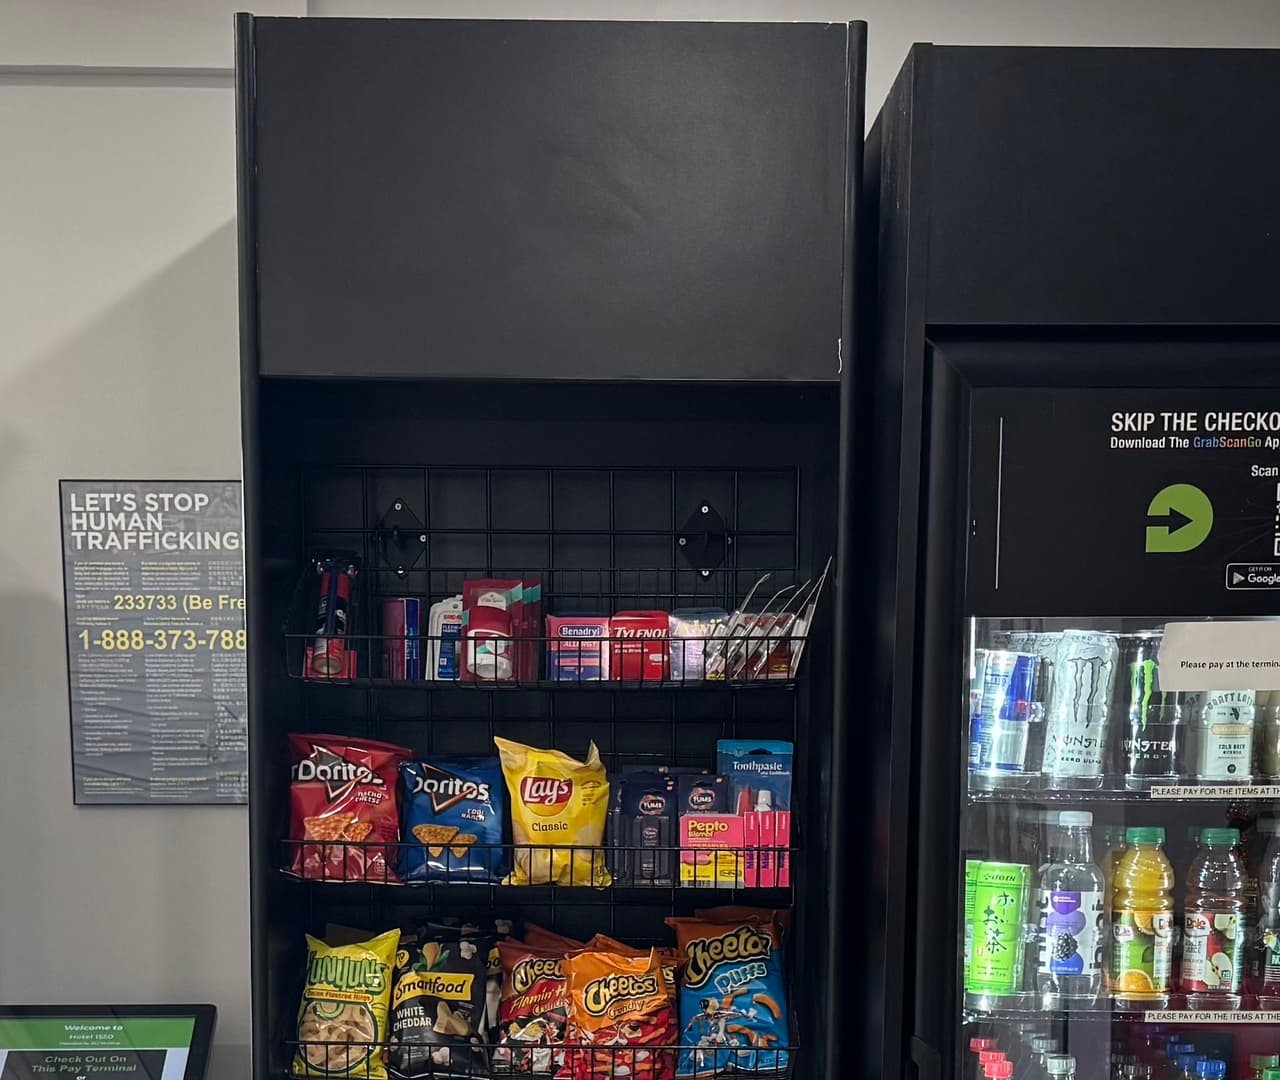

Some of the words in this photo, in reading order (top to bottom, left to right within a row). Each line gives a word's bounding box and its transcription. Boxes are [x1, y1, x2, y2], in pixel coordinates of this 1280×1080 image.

[1111, 412, 1155, 432] SKIP
[1161, 412, 1197, 432] THE
[1110, 436, 1165, 449] Download
[1169, 436, 1190, 448] The
[1193, 436, 1262, 449] GrabScanGo
[1251, 465, 1279, 477] Scan
[71, 493, 137, 512] LET'S
[145, 493, 209, 512] STOP
[72, 512, 163, 531] HUMAN
[114, 594, 177, 610] 233733
[183, 594, 213, 613] (Be
[562, 626, 600, 637] Benadryl
[1181, 660, 1207, 669] Please
[1208, 661, 1224, 670] pay
[1236, 660, 1250, 668] the
[733, 761, 783, 773] Toothpaste
[523, 777, 569, 803] Lay's
[1152, 788, 1182, 796] PLEASE
[1183, 787, 1198, 796] PAY
[1200, 787, 1217, 796] FOR
[1219, 787, 1233, 796] THE
[1235, 787, 1259, 795] ITEMS
[1260, 787, 1271, 795] AT
[532, 821, 569, 832] Classic
[688, 820, 729, 834] Pepto
[714, 963, 767, 994] PUFFS
[395, 977, 466, 1000] Smartfood
[585, 976, 658, 1015] Cheetos
[396, 1006, 425, 1019] WHITE
[1148, 1013, 1177, 1021] PLEASE
[1179, 1013, 1193, 1021] PAY
[1195, 1013, 1211, 1021] FOR
[1214, 1013, 1229, 1021] THE
[1230, 1013, 1253, 1021] ITEMS
[1254, 1013, 1264, 1021] AT
[1267, 1013, 1280, 1021] THE
[393, 1017, 432, 1032] CHEDDAR
[110, 1055, 127, 1063] On
[32, 1065, 56, 1073] This
[59, 1065, 81, 1074] Pay
[86, 1064, 137, 1072] Terminal
